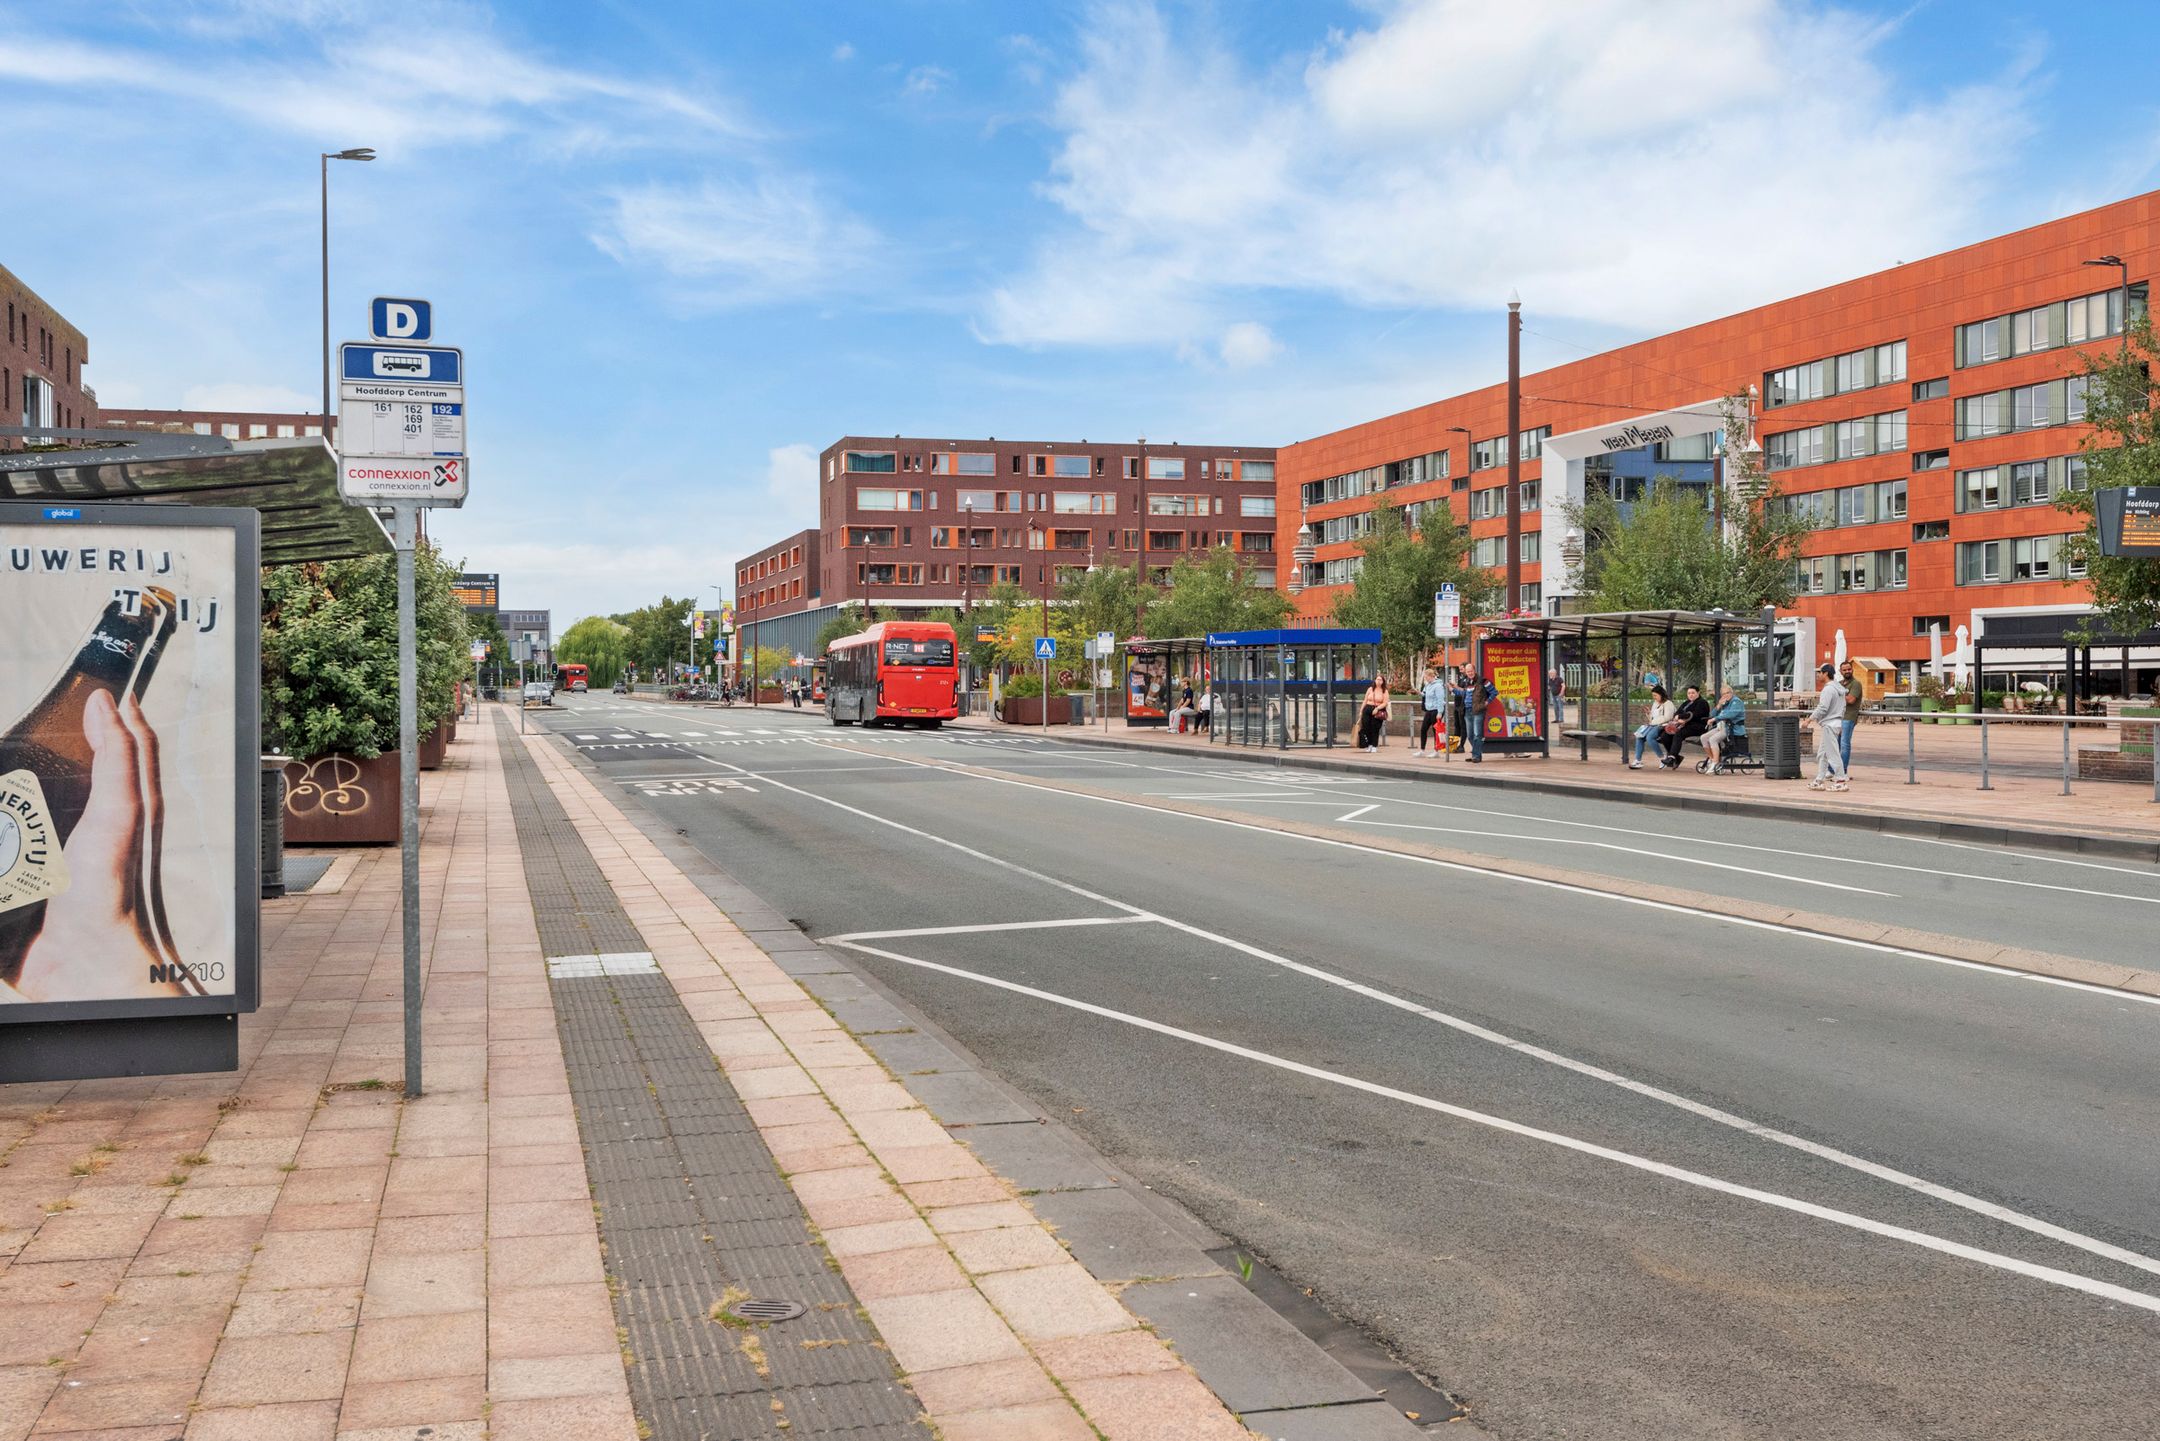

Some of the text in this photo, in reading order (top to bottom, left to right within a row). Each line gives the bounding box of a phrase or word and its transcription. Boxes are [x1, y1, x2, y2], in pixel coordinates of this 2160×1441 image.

[386, 303, 418, 337] D
[355, 387, 448, 399] Hoofddorp Centrum
[374, 403, 392, 412] 161
[404, 405, 423, 414] 162
[433, 405, 453, 415] 192
[404, 415, 423, 424] 169
[404, 424, 422, 433] 401
[348, 468, 431, 480] connexxion
[369, 482, 431, 491] connexxion.nl
[2126, 500, 2159, 509] Hoofddorp
[51, 509, 73, 519] global
